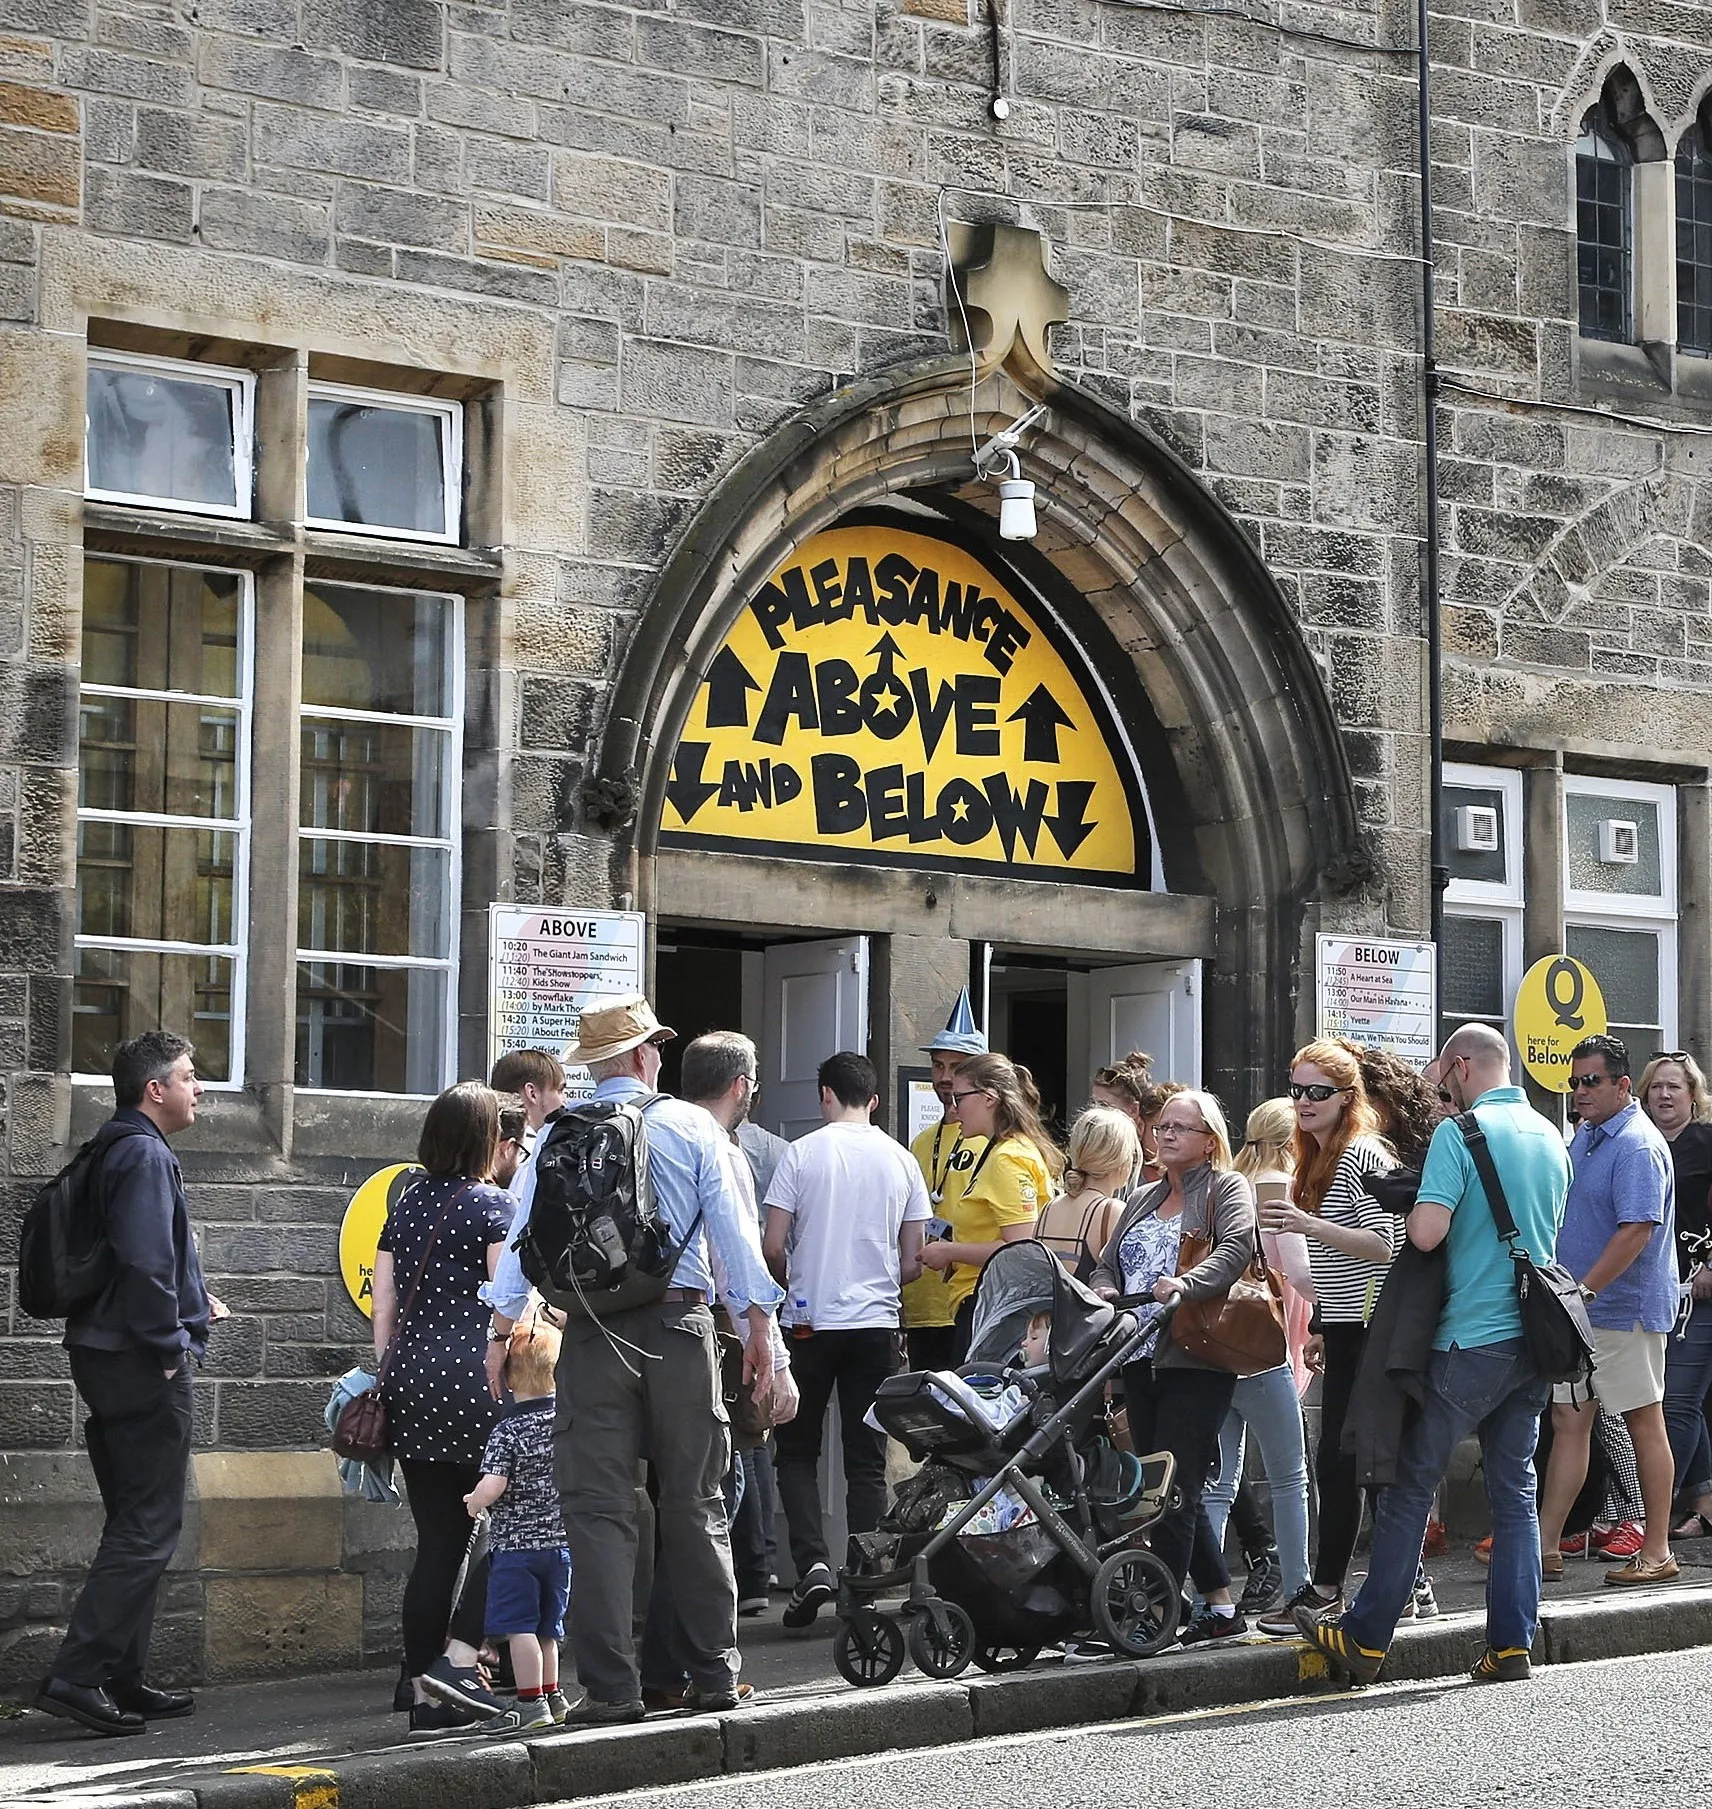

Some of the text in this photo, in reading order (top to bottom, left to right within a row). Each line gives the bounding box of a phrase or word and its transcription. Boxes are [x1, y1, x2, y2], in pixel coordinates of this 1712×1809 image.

[748, 553, 1031, 677] PLEASANCE
[753, 652, 1001, 765] ABOVE
[718, 753, 1051, 862] AND BELOW
[540, 919, 597, 938] ABOVE
[503, 942, 528, 950] 10:20
[533, 948, 628, 962] The Giant Jam Sandwich
[1355, 948, 1400, 964] BELOW
[503, 966, 527, 975] 11:40
[533, 968, 546, 976] The
[1327, 967, 1346, 976] 11:50
[533, 979, 570, 988] Kids Show
[1357, 974, 1373, 982] Heart
[1382, 976, 1392, 984] Sea
[502, 990, 527, 1000] 13:00
[532, 992, 574, 1003] Snowflake
[1327, 988, 1346, 997] 13:00
[1546, 958, 1585, 1030] Q
[1350, 995, 1362, 1003] Our
[1363, 995, 1377, 1004] Man
[532, 1004, 542, 1014] by
[544, 1004, 564, 1012] Mark
[1328, 1010, 1346, 1018] 14:15
[502, 1015, 526, 1024] 14:20
[540, 1017, 563, 1027] Super
[1350, 1016, 1370, 1025] Yvette
[532, 1029, 559, 1037] (About
[502, 1039, 526, 1048] 15:40
[1378, 1035, 1394, 1043] Think
[1408, 1037, 1429, 1045] Should
[1527, 1035, 1559, 1046] here for
[1527, 1046, 1573, 1066] Below
[921, 1105, 940, 1113] PLEASE
[958, 1151, 970, 1170] P
